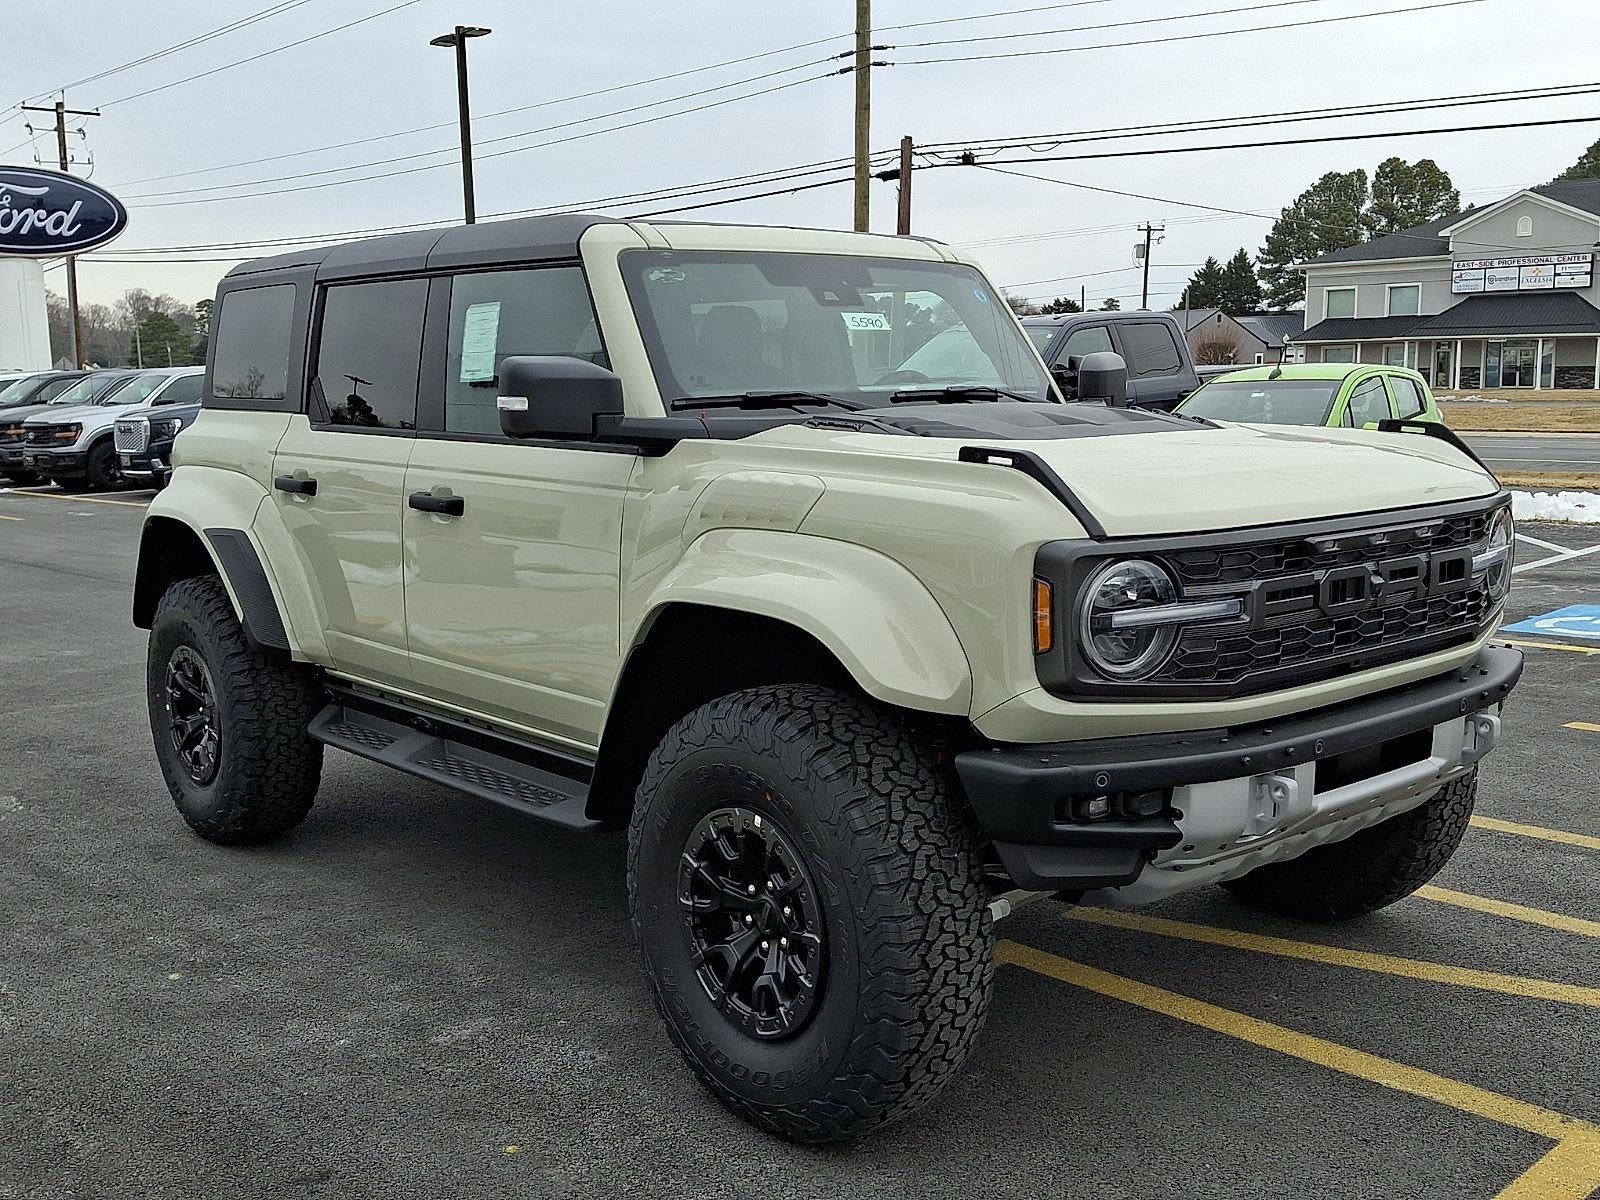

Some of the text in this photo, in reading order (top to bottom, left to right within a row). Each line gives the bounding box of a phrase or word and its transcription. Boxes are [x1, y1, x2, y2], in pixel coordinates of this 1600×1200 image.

[1456, 254, 1588, 269] EAST-SIDE PROFESSIONAL CENTER
[1250, 549, 1473, 629] FORD
